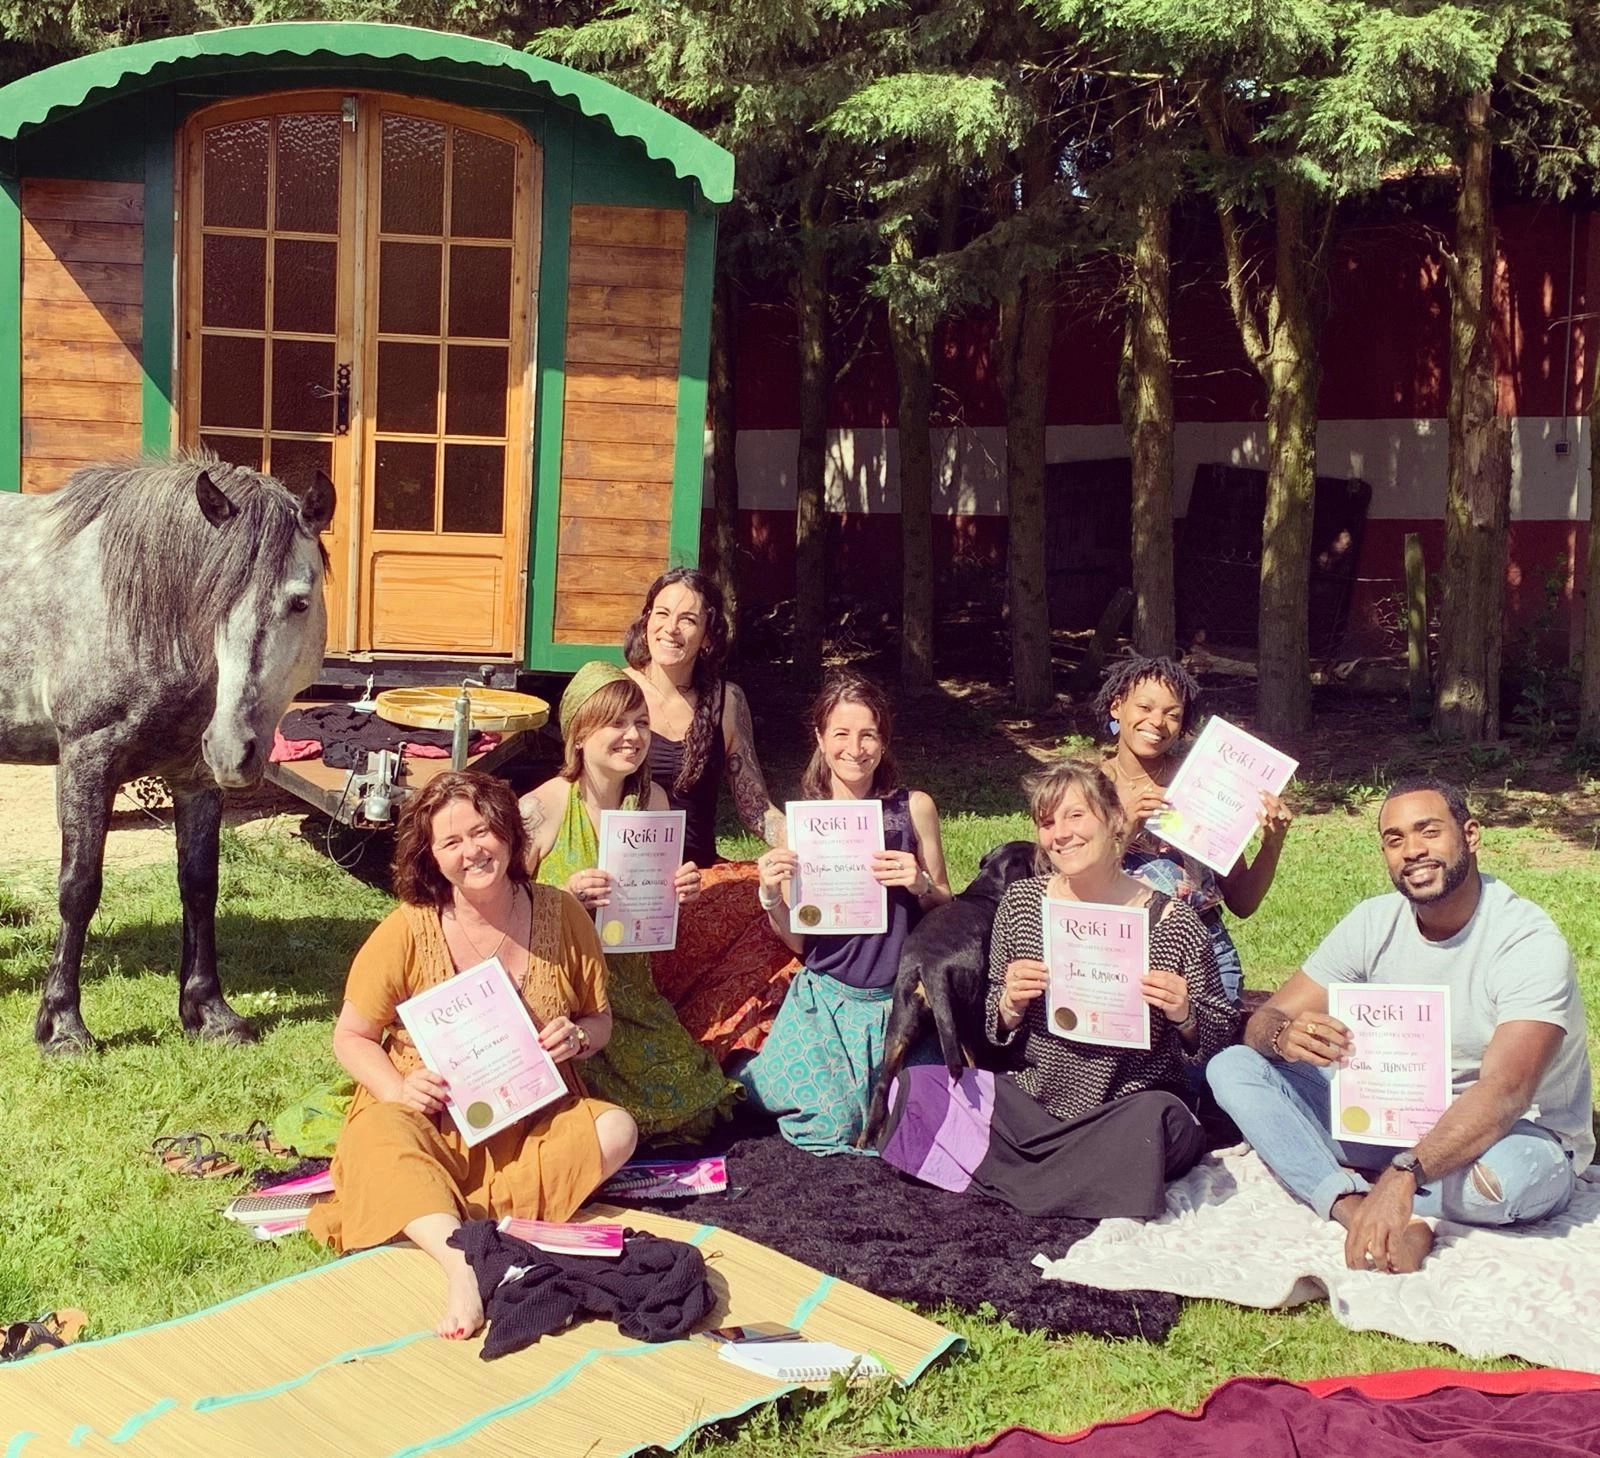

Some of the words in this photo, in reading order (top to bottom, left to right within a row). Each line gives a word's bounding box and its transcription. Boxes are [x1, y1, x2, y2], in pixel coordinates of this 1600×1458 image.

[1216, 741, 1257, 770] Reiki
[617, 828, 657, 850] Reiki
[804, 817, 847, 837] Reiki
[1059, 918, 1107, 941] Reiki
[1120, 923, 1133, 940] II
[424, 992, 473, 1027] Reiki
[1349, 1003, 1404, 1028] Reiki
[1416, 1004, 1433, 1022] II
